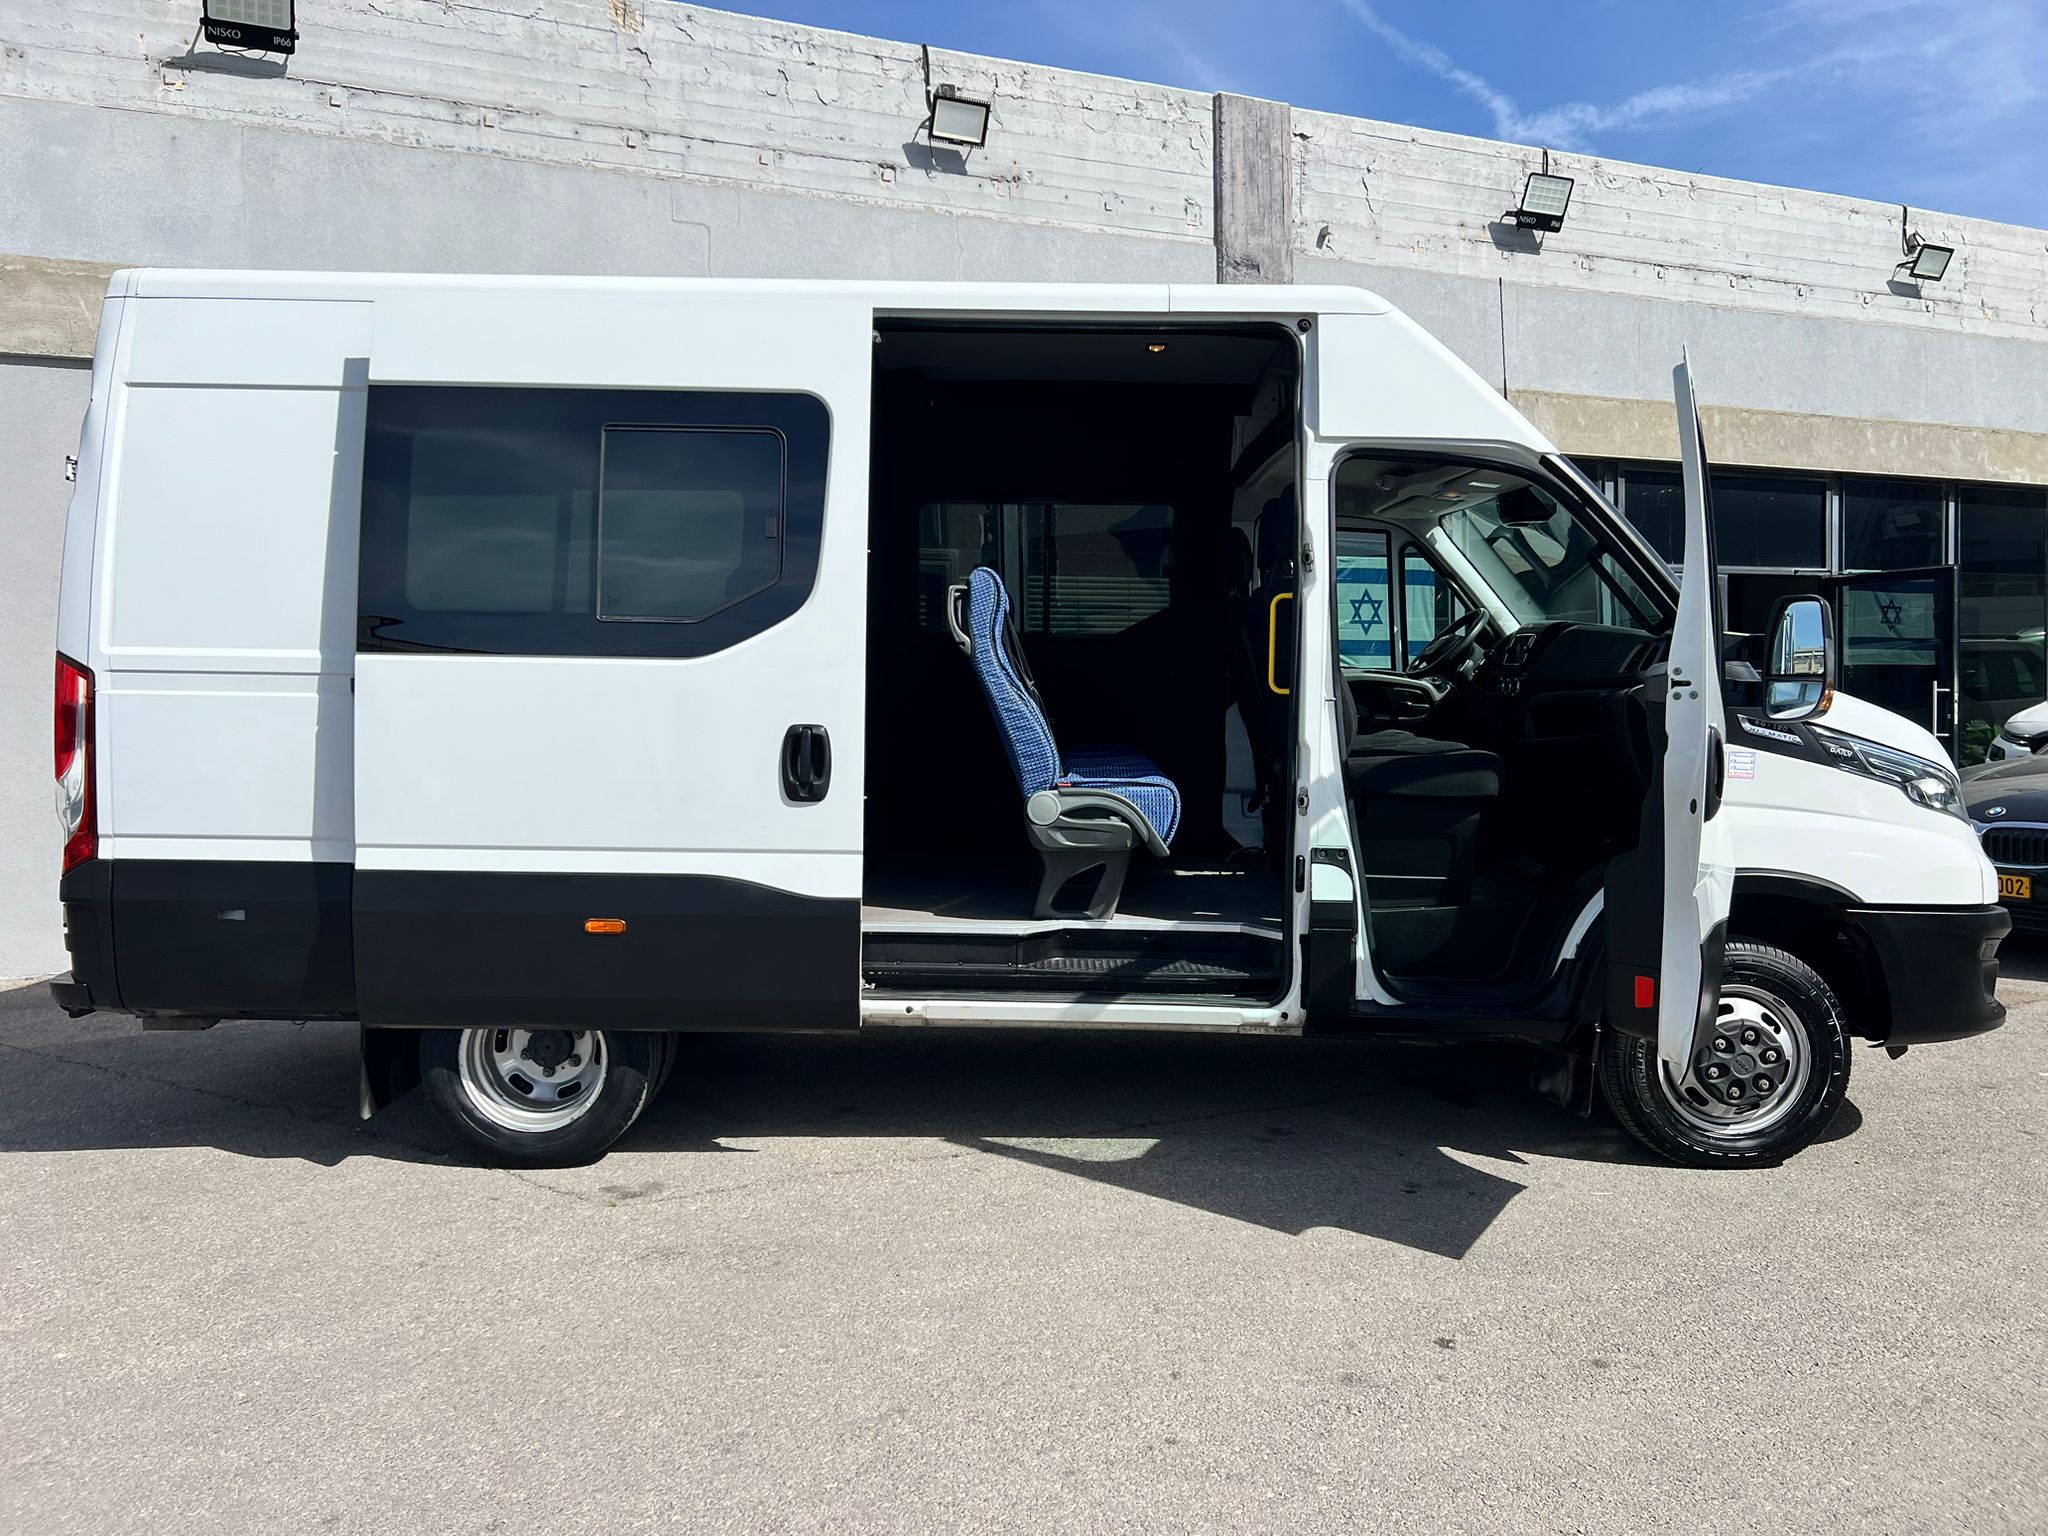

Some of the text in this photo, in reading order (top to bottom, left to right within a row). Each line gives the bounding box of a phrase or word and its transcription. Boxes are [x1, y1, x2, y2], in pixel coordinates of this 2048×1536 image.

[208, 26, 241, 39] NISKO
[273, 36, 292, 47] IP66
[1830, 747, 1853, 757] DAILY
